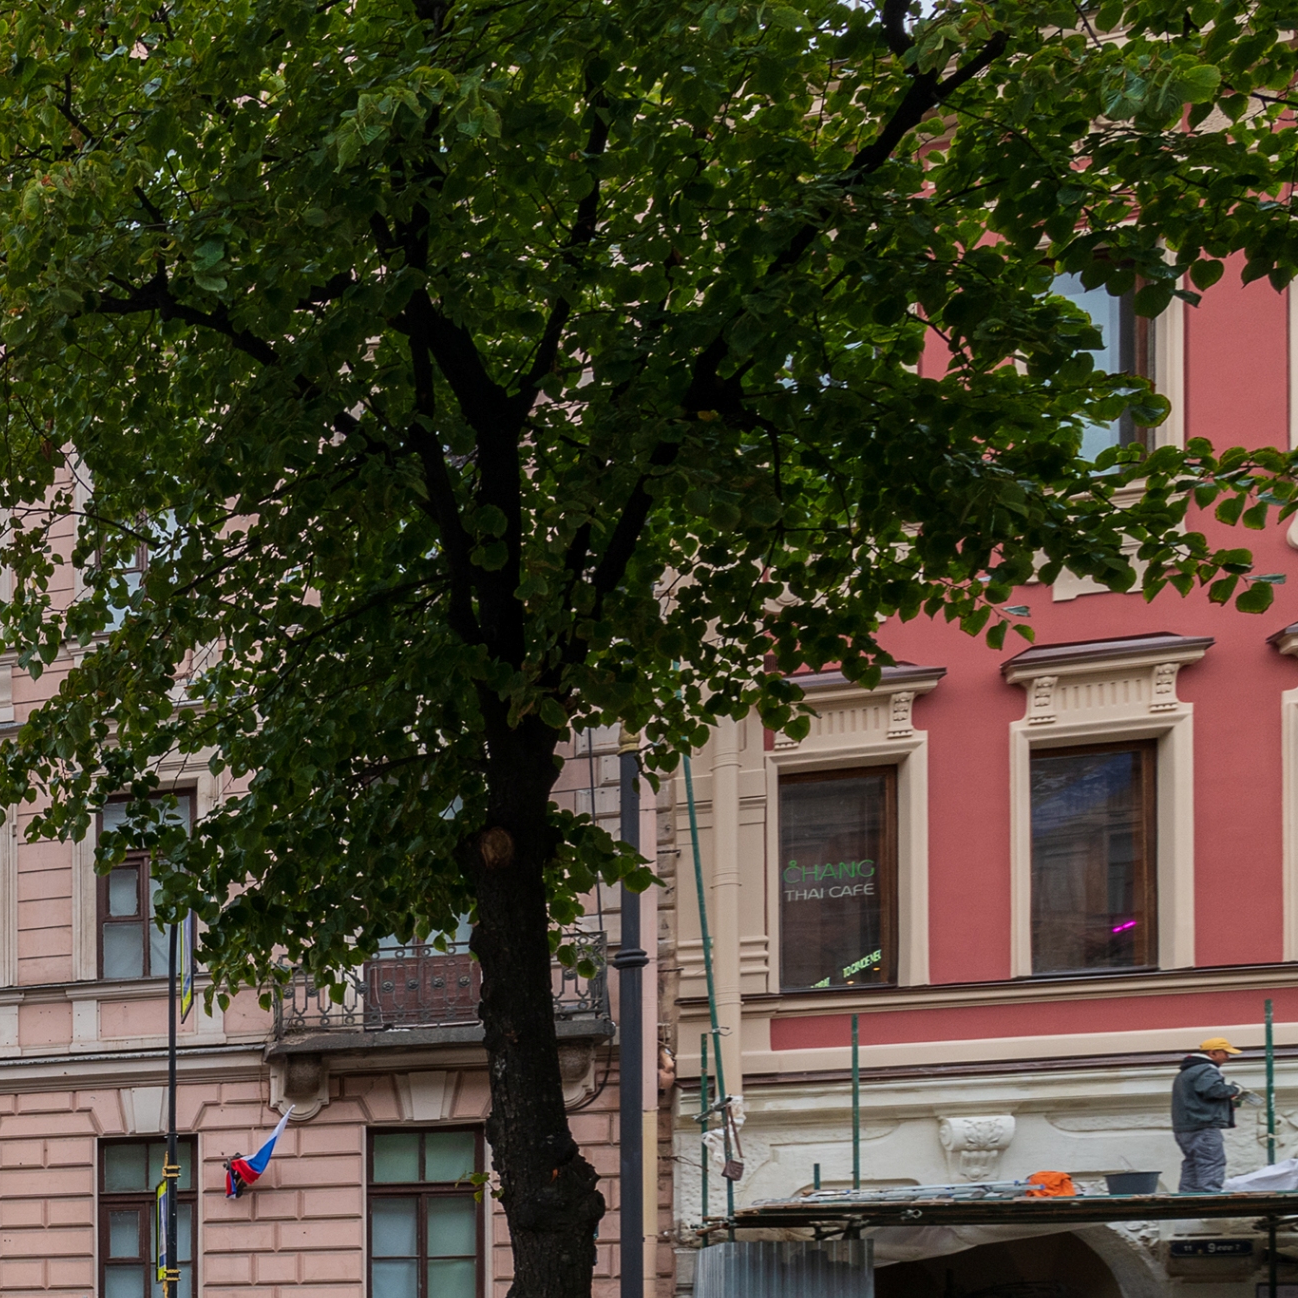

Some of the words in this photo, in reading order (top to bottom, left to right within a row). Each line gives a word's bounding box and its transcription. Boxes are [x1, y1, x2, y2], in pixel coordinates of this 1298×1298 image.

[783, 859, 875, 884] CHANG
[784, 888, 824, 902] THAI
[829, 883, 875, 898] CAFE
